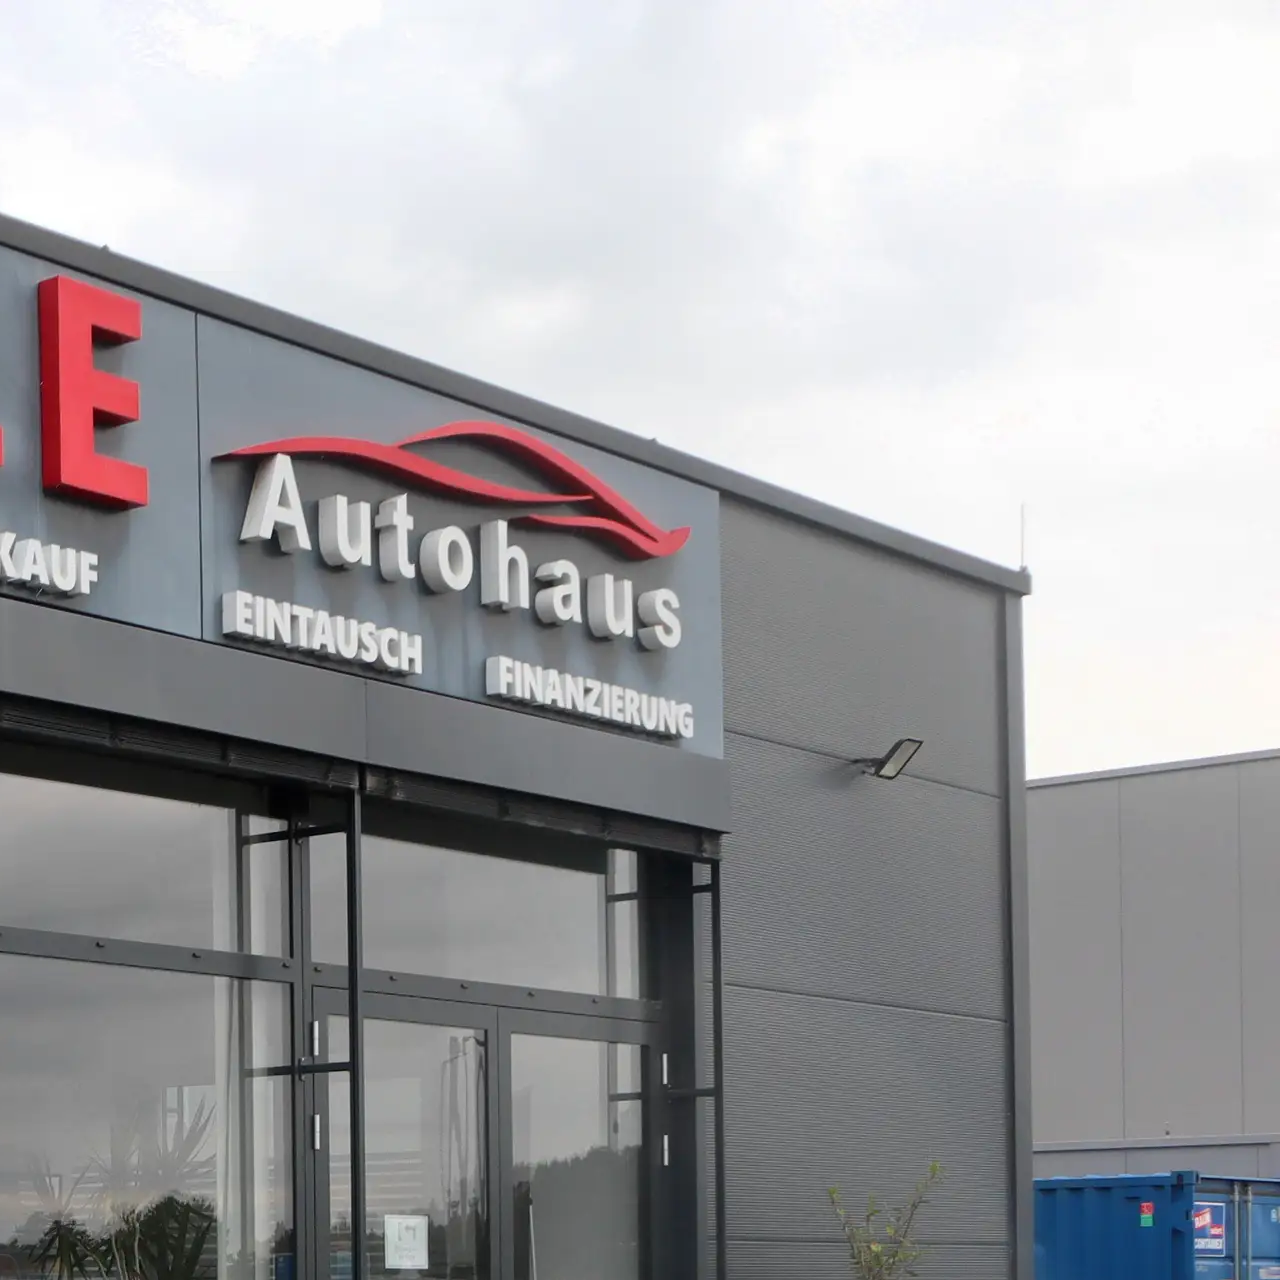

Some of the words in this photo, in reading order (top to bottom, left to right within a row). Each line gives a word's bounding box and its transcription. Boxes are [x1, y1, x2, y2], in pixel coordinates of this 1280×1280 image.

[240, 453, 681, 651] Autohaus
[222, 590, 422, 675] EINTAUSCH
[486, 656, 695, 739] FINANZIERUNG
